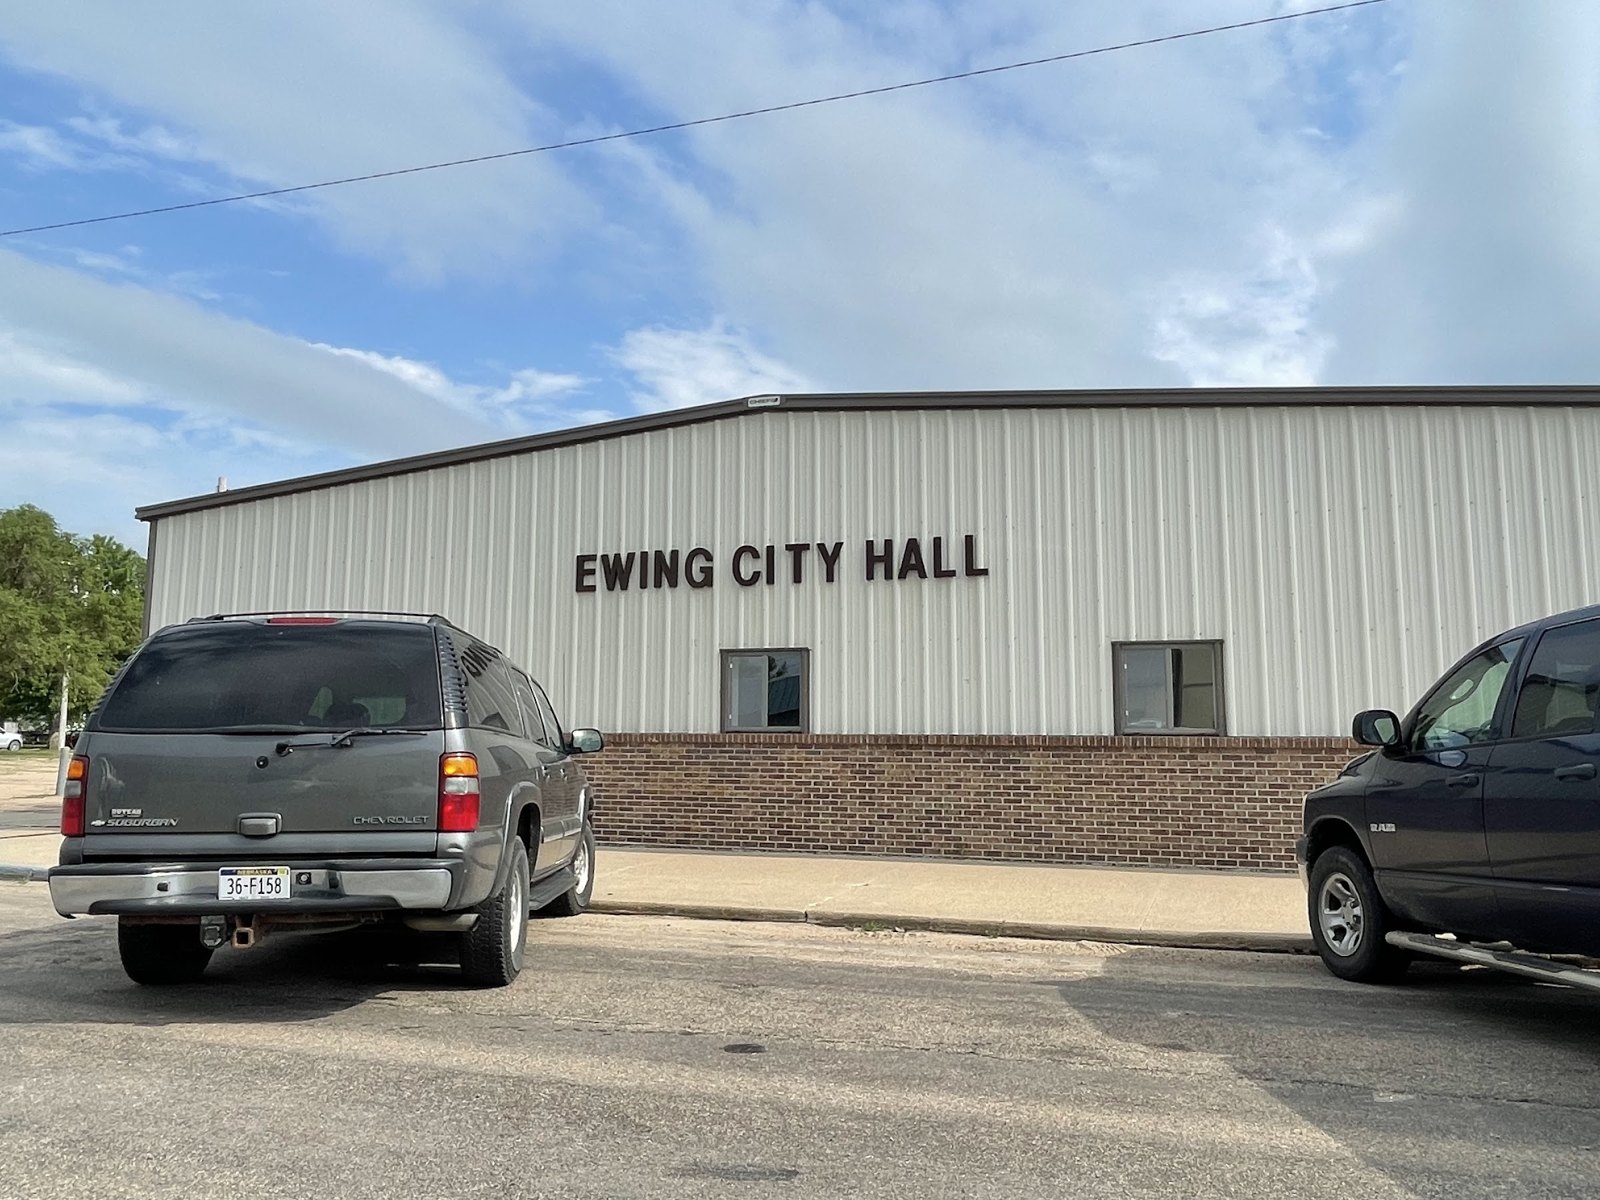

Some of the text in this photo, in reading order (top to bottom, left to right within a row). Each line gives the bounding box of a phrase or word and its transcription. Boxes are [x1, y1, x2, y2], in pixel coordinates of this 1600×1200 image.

[575, 534, 989, 593] EWING CITY HALL
[106, 818, 179, 826] SUBURBAN
[353, 815, 430, 824] CHEVROLET
[1370, 823, 1396, 832] RAM
[227, 877, 282, 895] 36-F158
